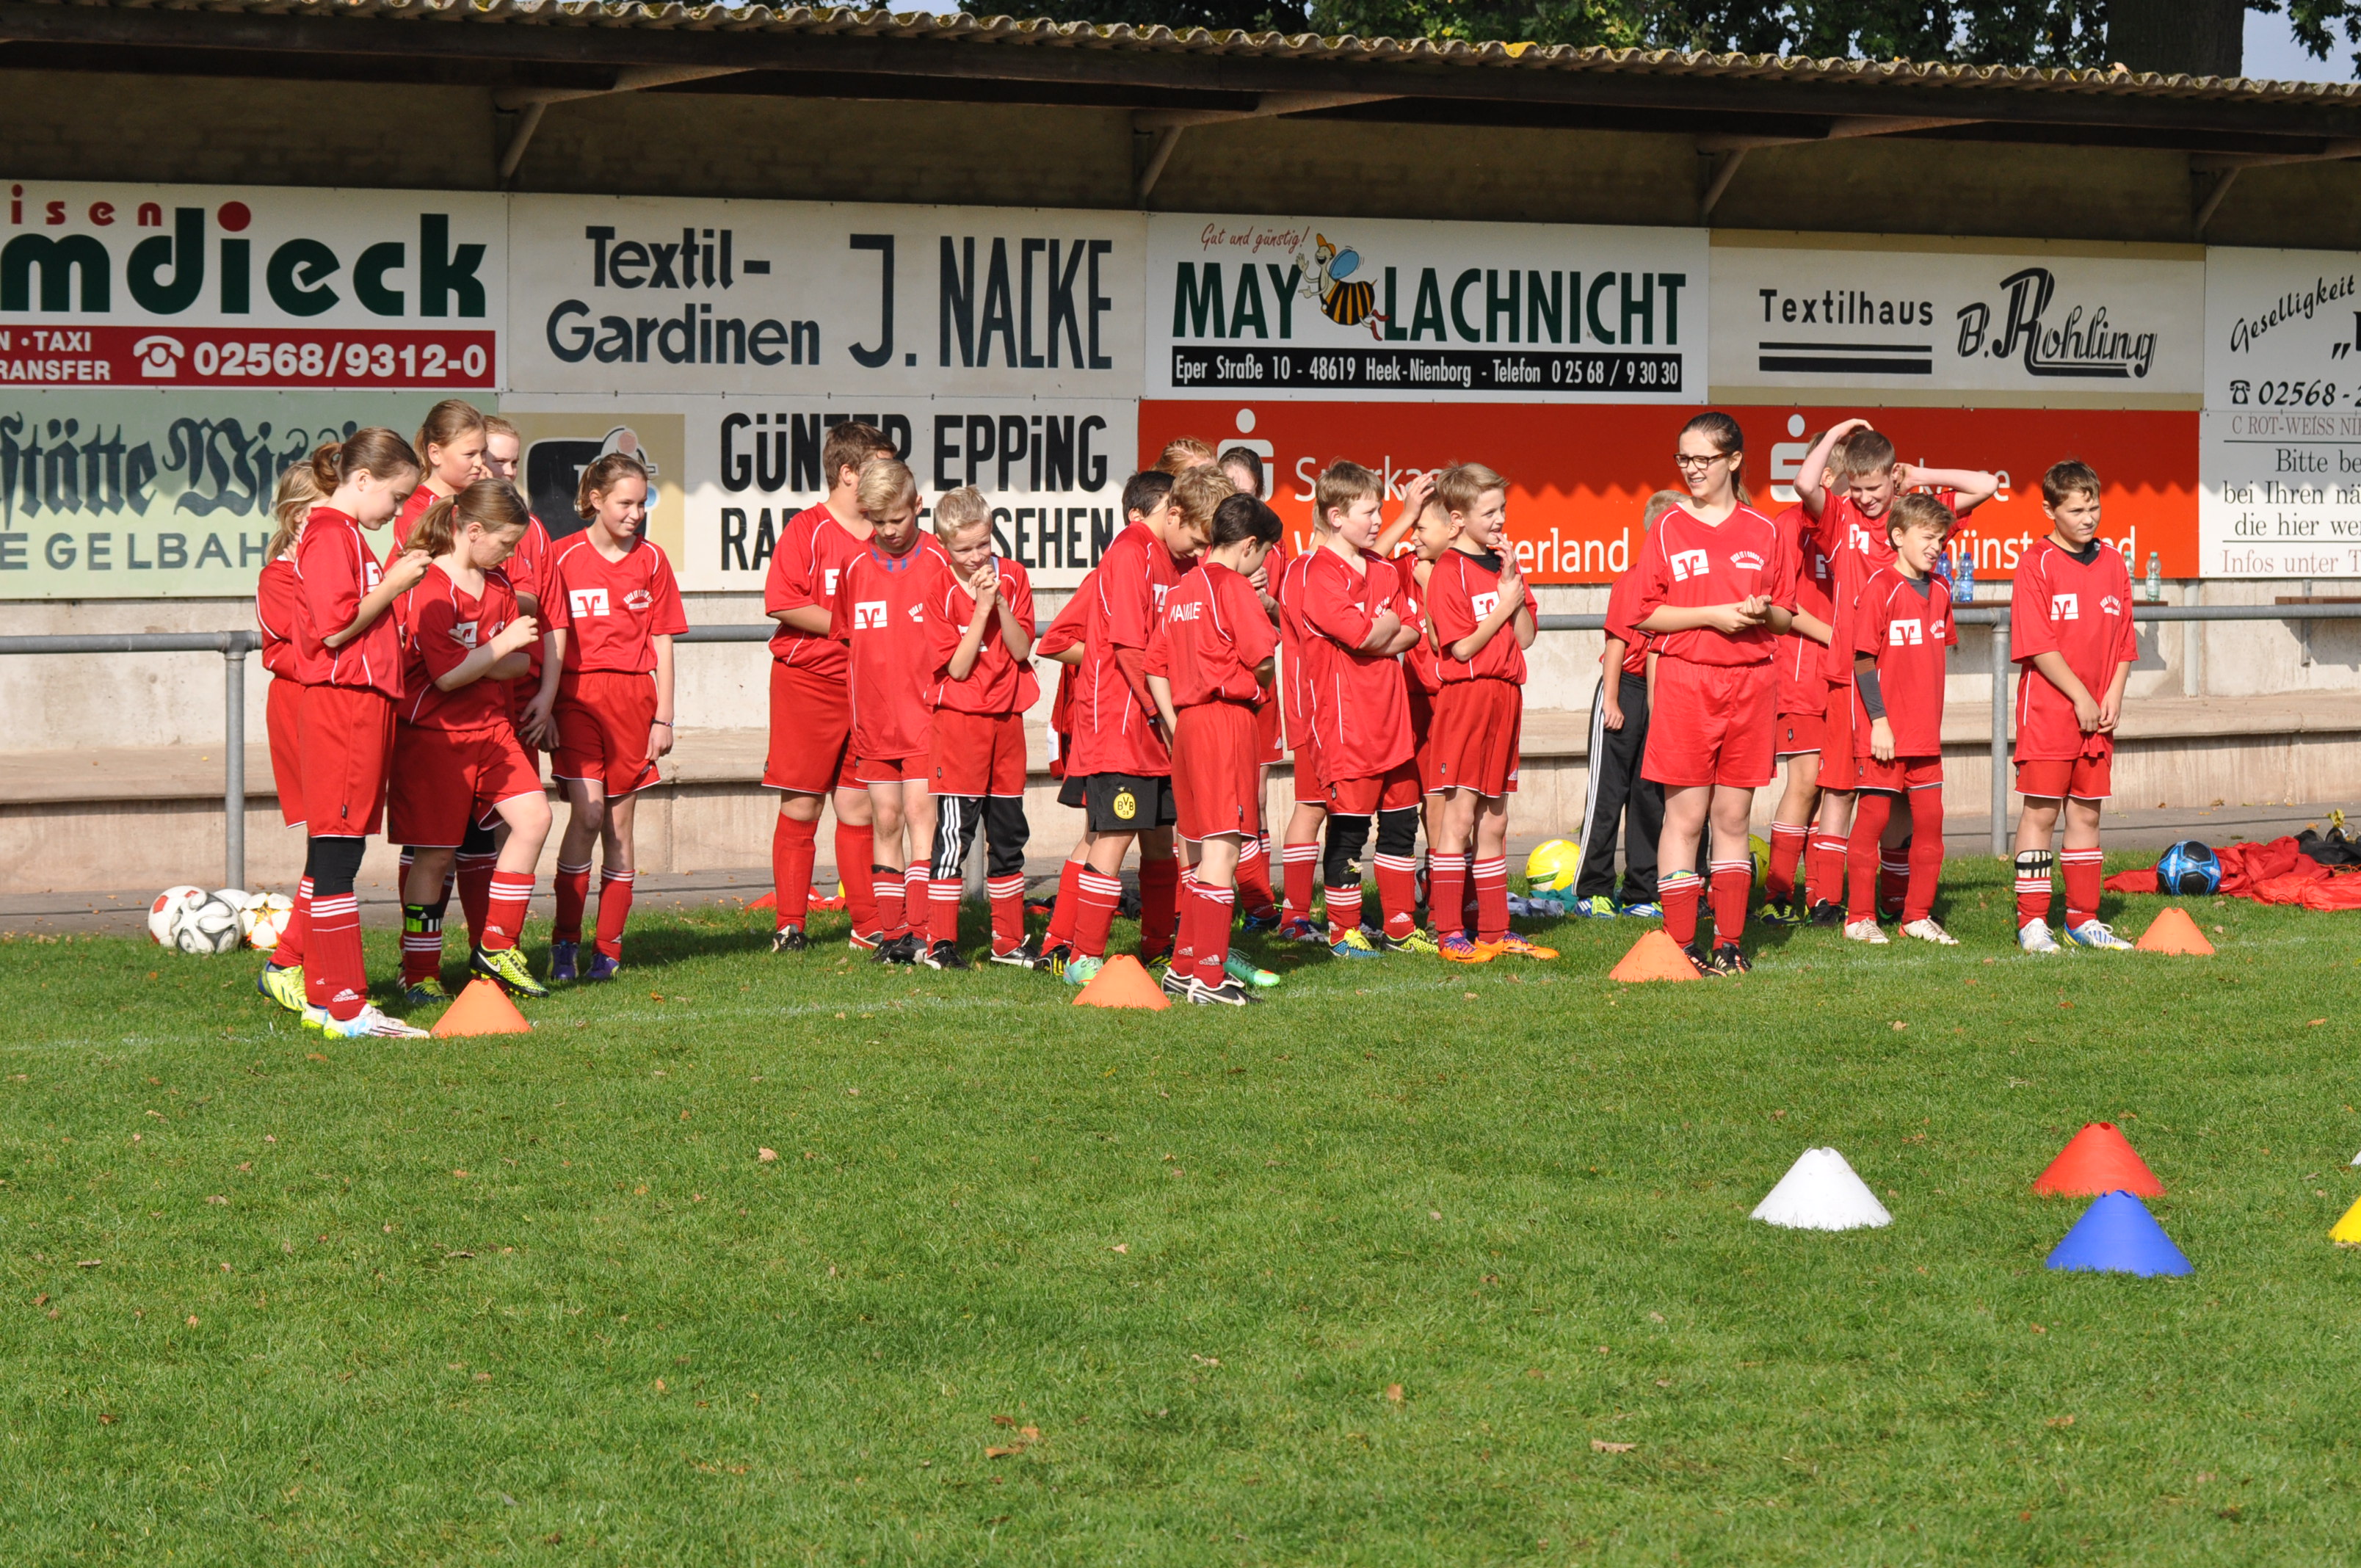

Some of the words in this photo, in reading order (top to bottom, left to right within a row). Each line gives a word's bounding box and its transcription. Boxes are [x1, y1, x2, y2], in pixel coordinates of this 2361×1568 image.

[1200, 222, 1225, 252] Gut
[1229, 226, 1253, 246] und
[1252, 225, 1310, 255] günstig!
[848, 233, 918, 369] J.
[940, 236, 1113, 370] NACKE
[1172, 261, 1303, 340] MAY
[1384, 266, 1687, 346] LACHNICHT
[1759, 288, 1934, 327] Textilhaus
[2230, 274, 2355, 355] Geselligkeit
[33, 331, 92, 352] TAXI
[546, 299, 821, 366] Gardinen
[193, 341, 487, 379] 02568/9312-0
[1175, 354, 1208, 385] Eper
[1216, 353, 1263, 380] Straße
[1272, 355, 1291, 380] 10
[1309, 356, 1357, 382] 48619
[1366, 355, 1472, 388] Heek-Nienborg
[1493, 357, 1541, 383] Telefon
[2257, 379, 2337, 407] 02568
[2275, 448, 2329, 473] Bitte
[2223, 480, 2255, 505] bei
[2264, 480, 2324, 505] Ihren
[2234, 512, 2267, 536] die
[2277, 512, 2320, 536] hier
[2329, 519, 2361, 536] we
[2222, 548, 2274, 574] Infos
[2284, 551, 2339, 575] unter
